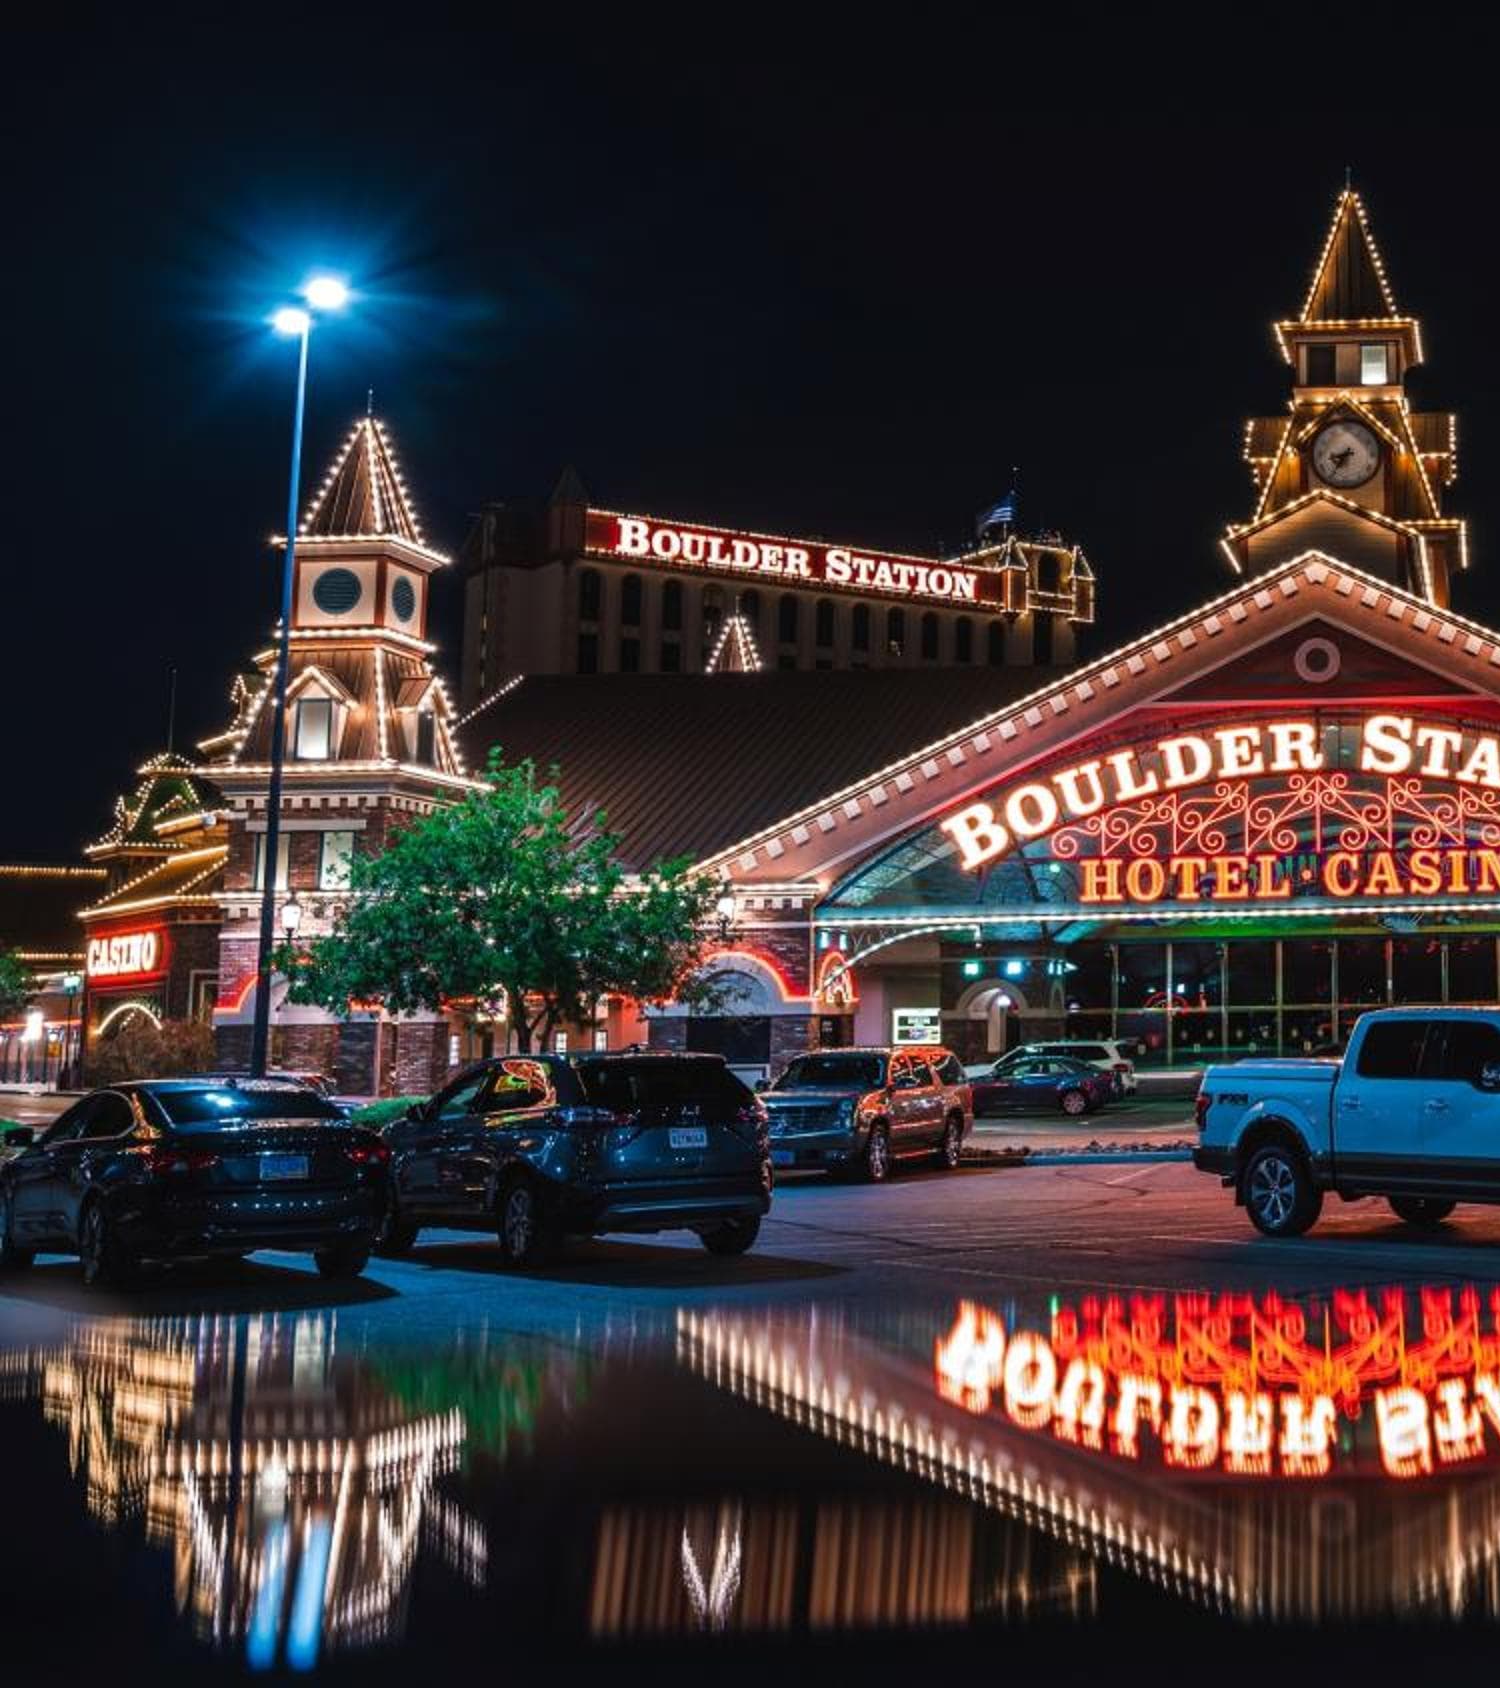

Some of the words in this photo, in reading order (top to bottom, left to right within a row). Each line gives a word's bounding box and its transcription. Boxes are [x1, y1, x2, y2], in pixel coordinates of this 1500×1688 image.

[616, 517, 812, 577] BOULDER
[825, 550, 978, 600] STATION
[939, 721, 1325, 872] BOULDER
[1079, 857, 1291, 901] HOTEL
[87, 931, 157, 977] CASINO
